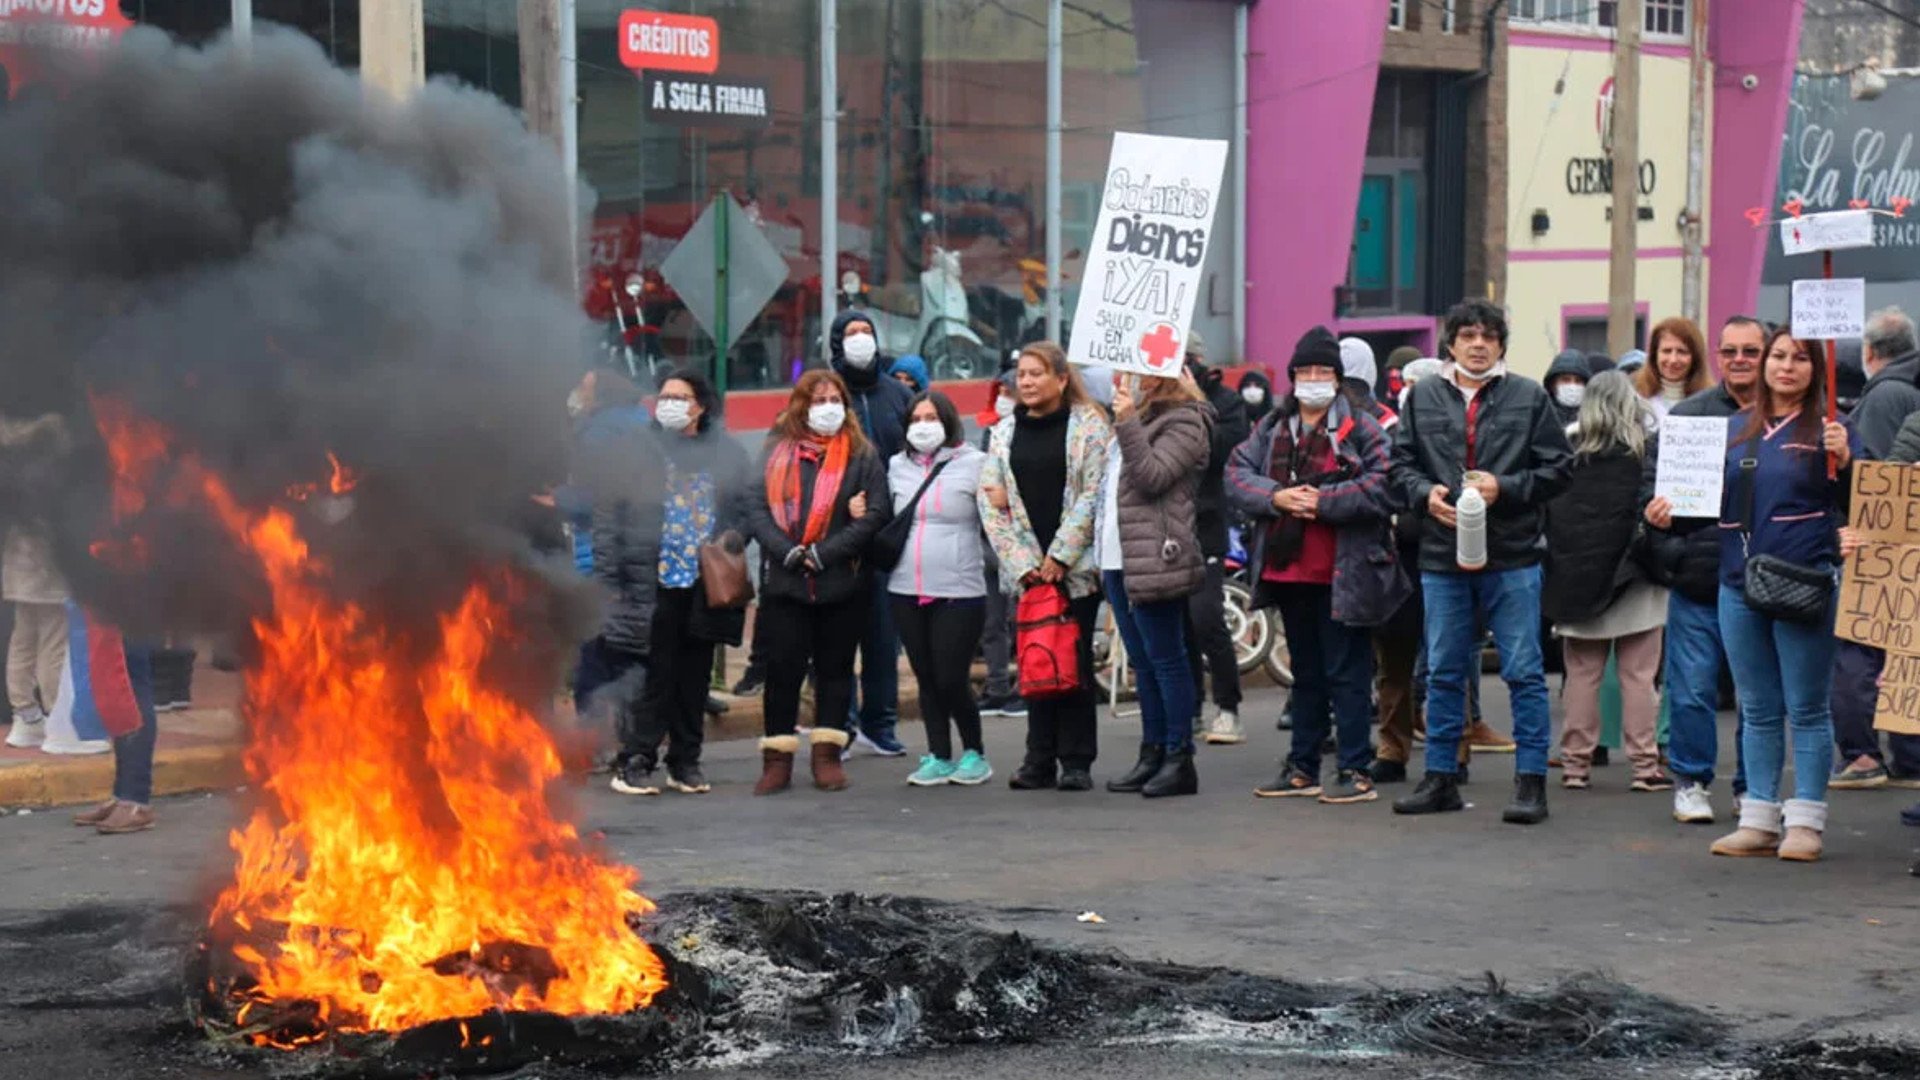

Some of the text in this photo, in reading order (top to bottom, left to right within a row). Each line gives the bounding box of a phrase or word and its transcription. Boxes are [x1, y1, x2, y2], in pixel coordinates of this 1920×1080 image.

[628, 18, 710, 58] CRÉDITOS
[652, 81, 767, 116] A SOLA FIRMA
[1785, 124, 1840, 208] La
[1095, 309, 1137, 332] SALUD
[1089, 340, 1134, 363] LUCHA
[1104, 328, 1123, 345] EN
[1857, 463, 1920, 497] ESTE
[1856, 499, 1894, 530] NO
[1851, 617, 1912, 648] COMO
